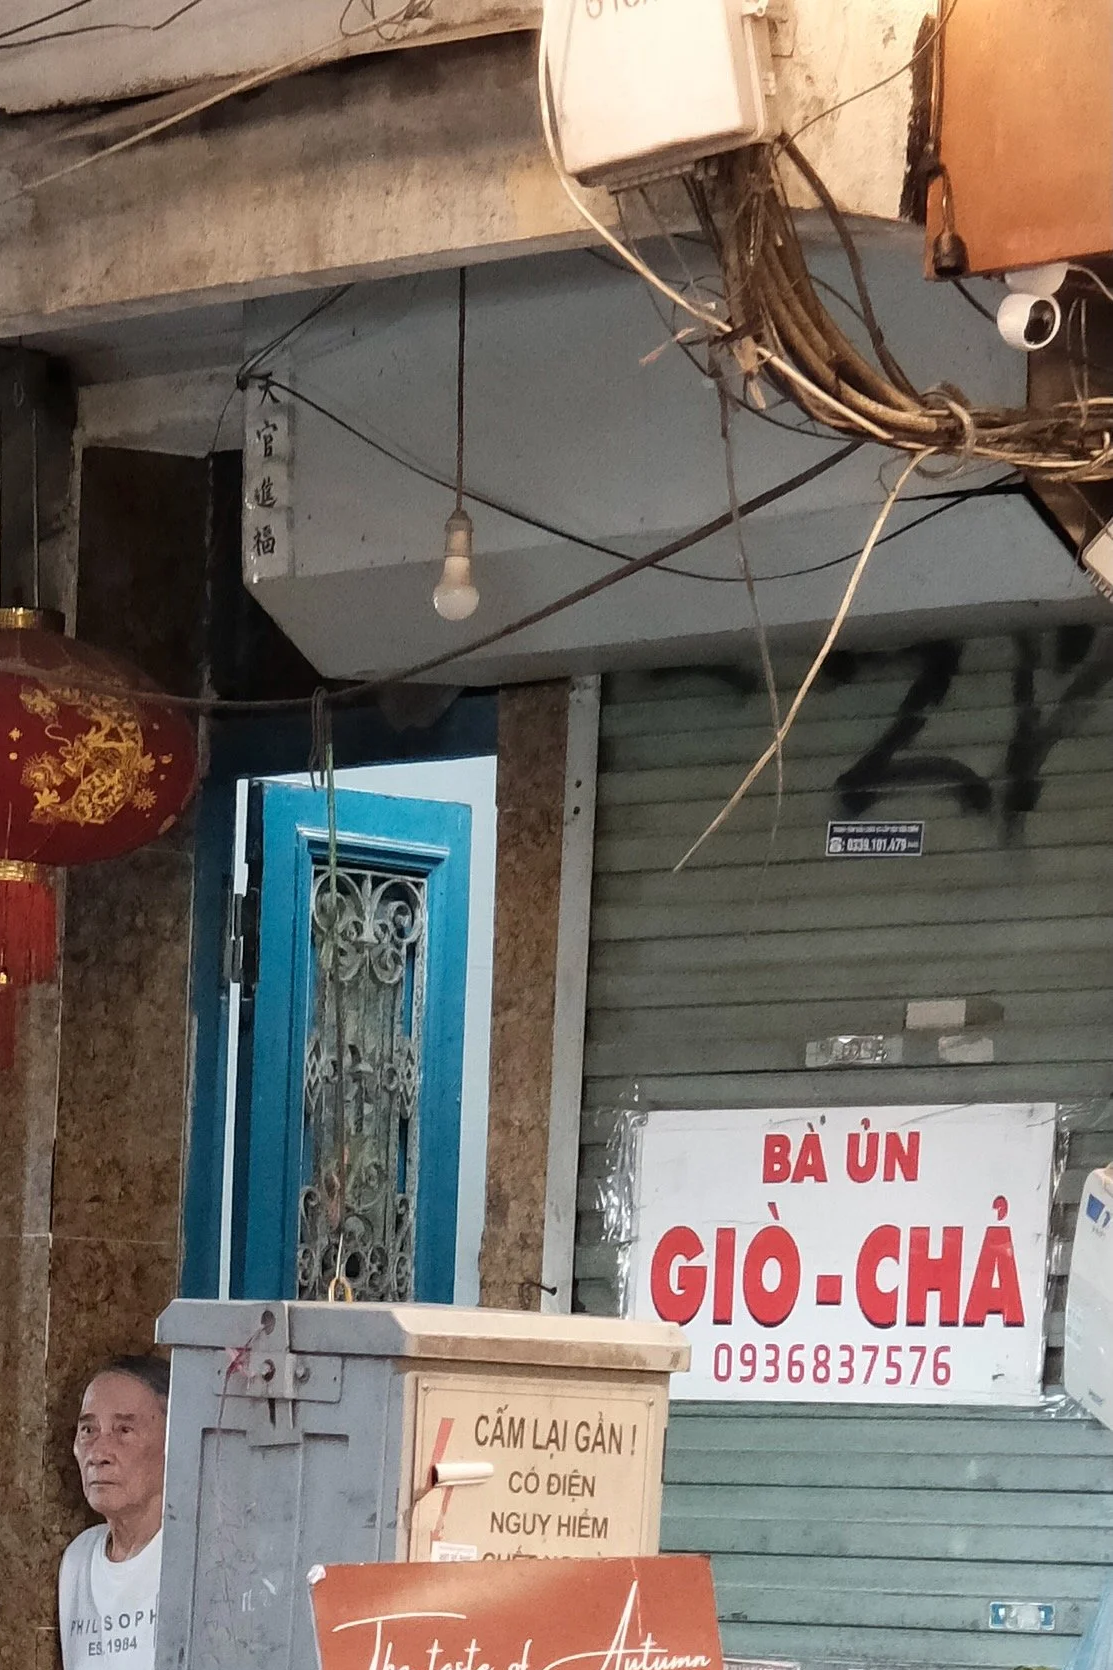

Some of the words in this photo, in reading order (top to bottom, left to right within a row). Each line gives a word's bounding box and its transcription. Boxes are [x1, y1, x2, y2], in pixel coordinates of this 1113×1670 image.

[762, 1123, 827, 1184] BÀ
[846, 1117, 921, 1183] ỦN
[713, 1342, 953, 1386] 0936837576
[474, 1404, 526, 1449] CẤM
[532, 1418, 568, 1460] LẠI
[508, 1466, 540, 1495] CÓ
[546, 1468, 597, 1503] ĐIỆN
[490, 1511, 552, 1536] NGUY
[557, 1507, 609, 1540] HIỂM
[107, 1635, 138, 1653] 1984
